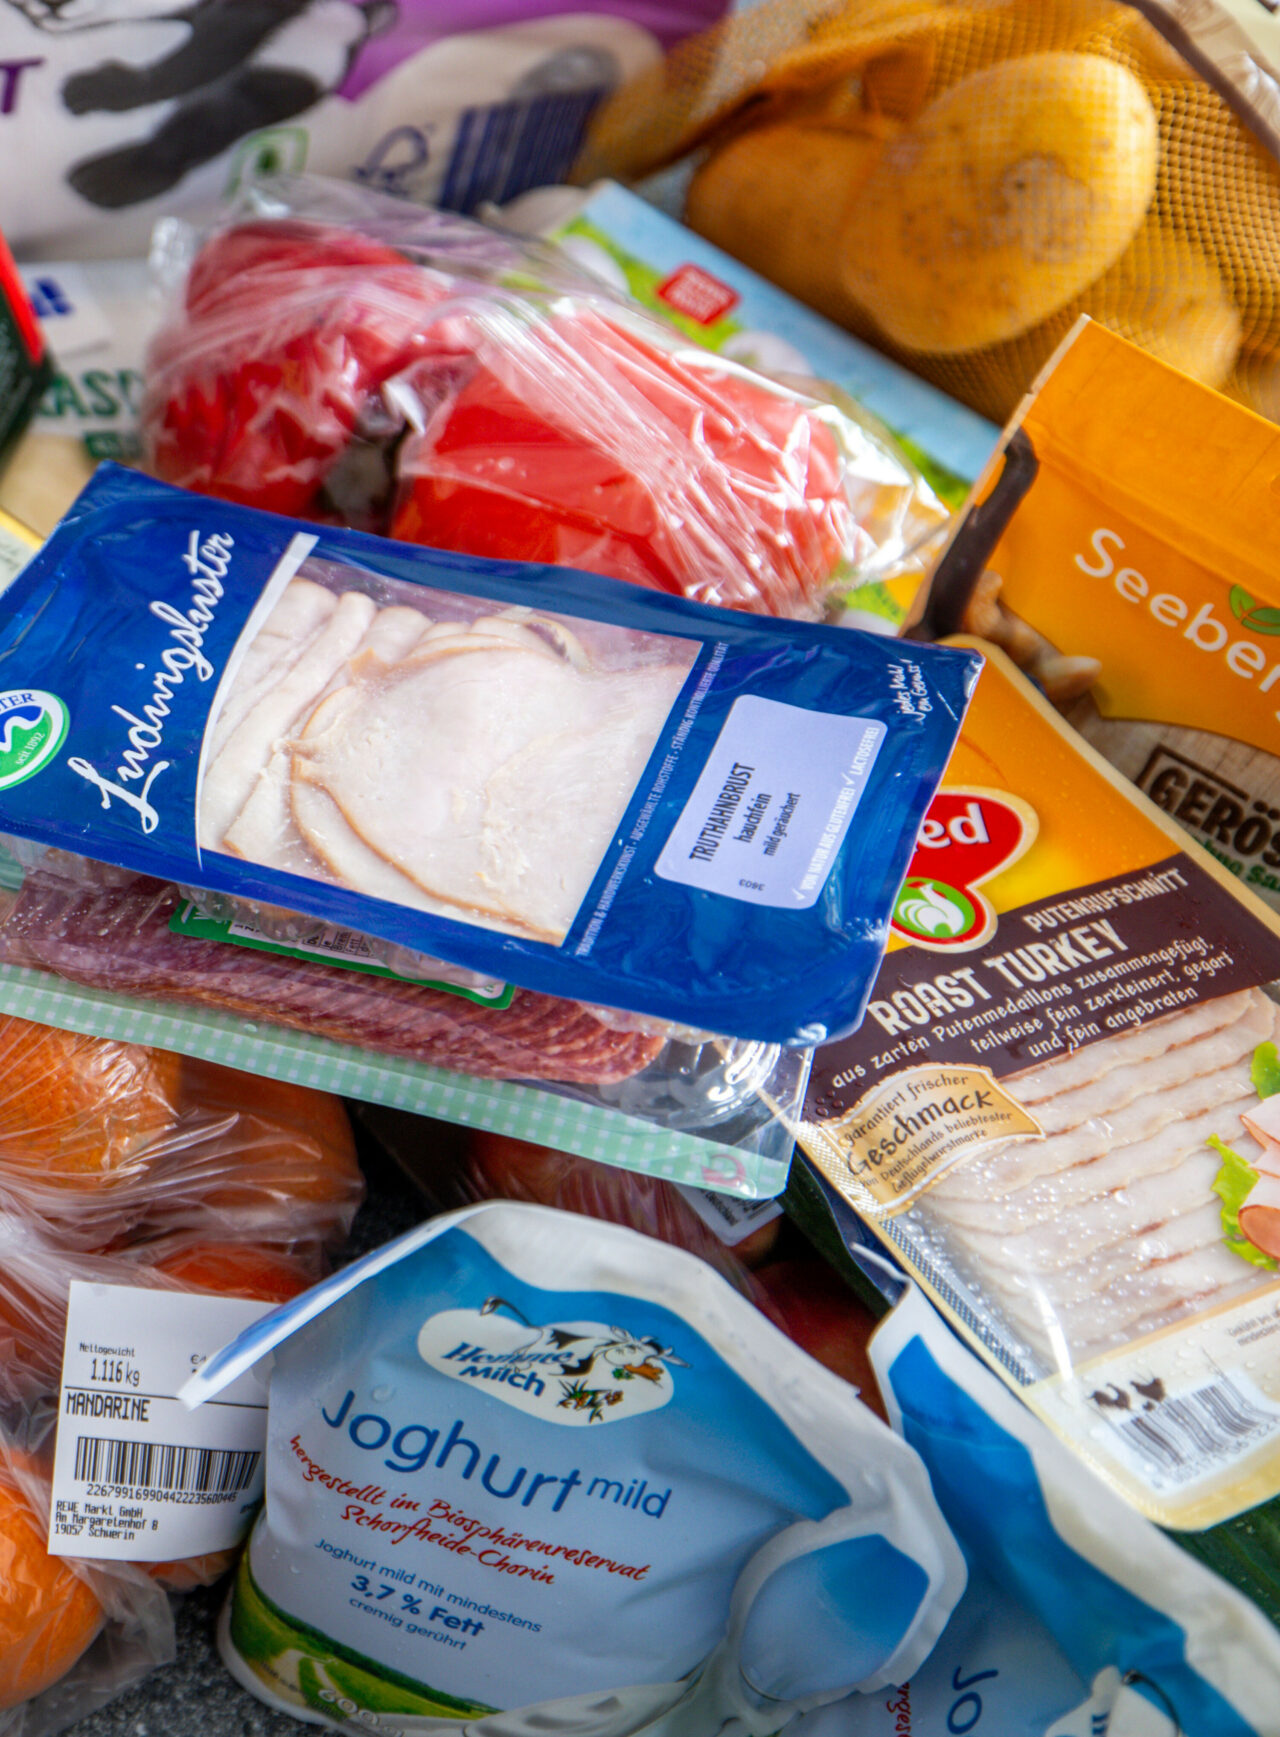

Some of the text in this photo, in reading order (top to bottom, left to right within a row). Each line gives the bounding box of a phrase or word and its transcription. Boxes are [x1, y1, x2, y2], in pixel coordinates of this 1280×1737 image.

[1074, 527, 1280, 693] Seeber
[67, 529, 235, 834] Ludwigsluster
[628, 790, 662, 842] AUSGEWÄHLTE
[650, 752, 679, 794] ROHSTOFFE
[668, 716, 695, 752] STÄNDIG
[689, 759, 755, 867] TRUTHAHNBRUST
[807, 845, 831, 876] NATUR
[823, 784, 858, 835] GLUTENFREI
[847, 724, 883, 777] LACTOSEFREI
[733, 789, 773, 846] hauchfein
[760, 789, 804, 858] mild geräuchert
[1023, 867, 1189, 935] PUTENAUFSCHNITT
[832, 934, 1215, 1090] aus zarten Putenmedaillons zusammengefügt,
[867, 919, 1131, 1038] ROAST TURKEY
[970, 950, 1234, 1053] teilweise fein zerkleinert, gegart
[1028, 985, 1198, 1059] und fein angebraten
[840, 1069, 971, 1148] garantiert frischer
[844, 1089, 996, 1178] Geschmack
[879, 1109, 1015, 1181] Deutschlands beliebtester
[890, 1127, 988, 1197] Geflügelwurstmarke
[90, 1358, 140, 1387] 1.116 kg
[442, 1341, 574, 1366] Hemme
[458, 1364, 547, 1398] Milch
[65, 1391, 151, 1423] MANDARINE
[321, 1390, 673, 1520] Joghurt mild
[55, 1523, 136, 1541] 19057 Schwerin
[56, 1500, 144, 1519] REWE Markt GmbH
[56, 1513, 148, 1531] Am Margaretenhof
[289, 1434, 652, 1583] hergestellt im Biosphärenreservat
[340, 1503, 556, 1587] Schorfheide-Chorin
[314, 1536, 544, 1635] Joghurt mild mit mindestens
[350, 1573, 487, 1639] 3,7 % Fett
[348, 1597, 468, 1652] cremig gerührt
